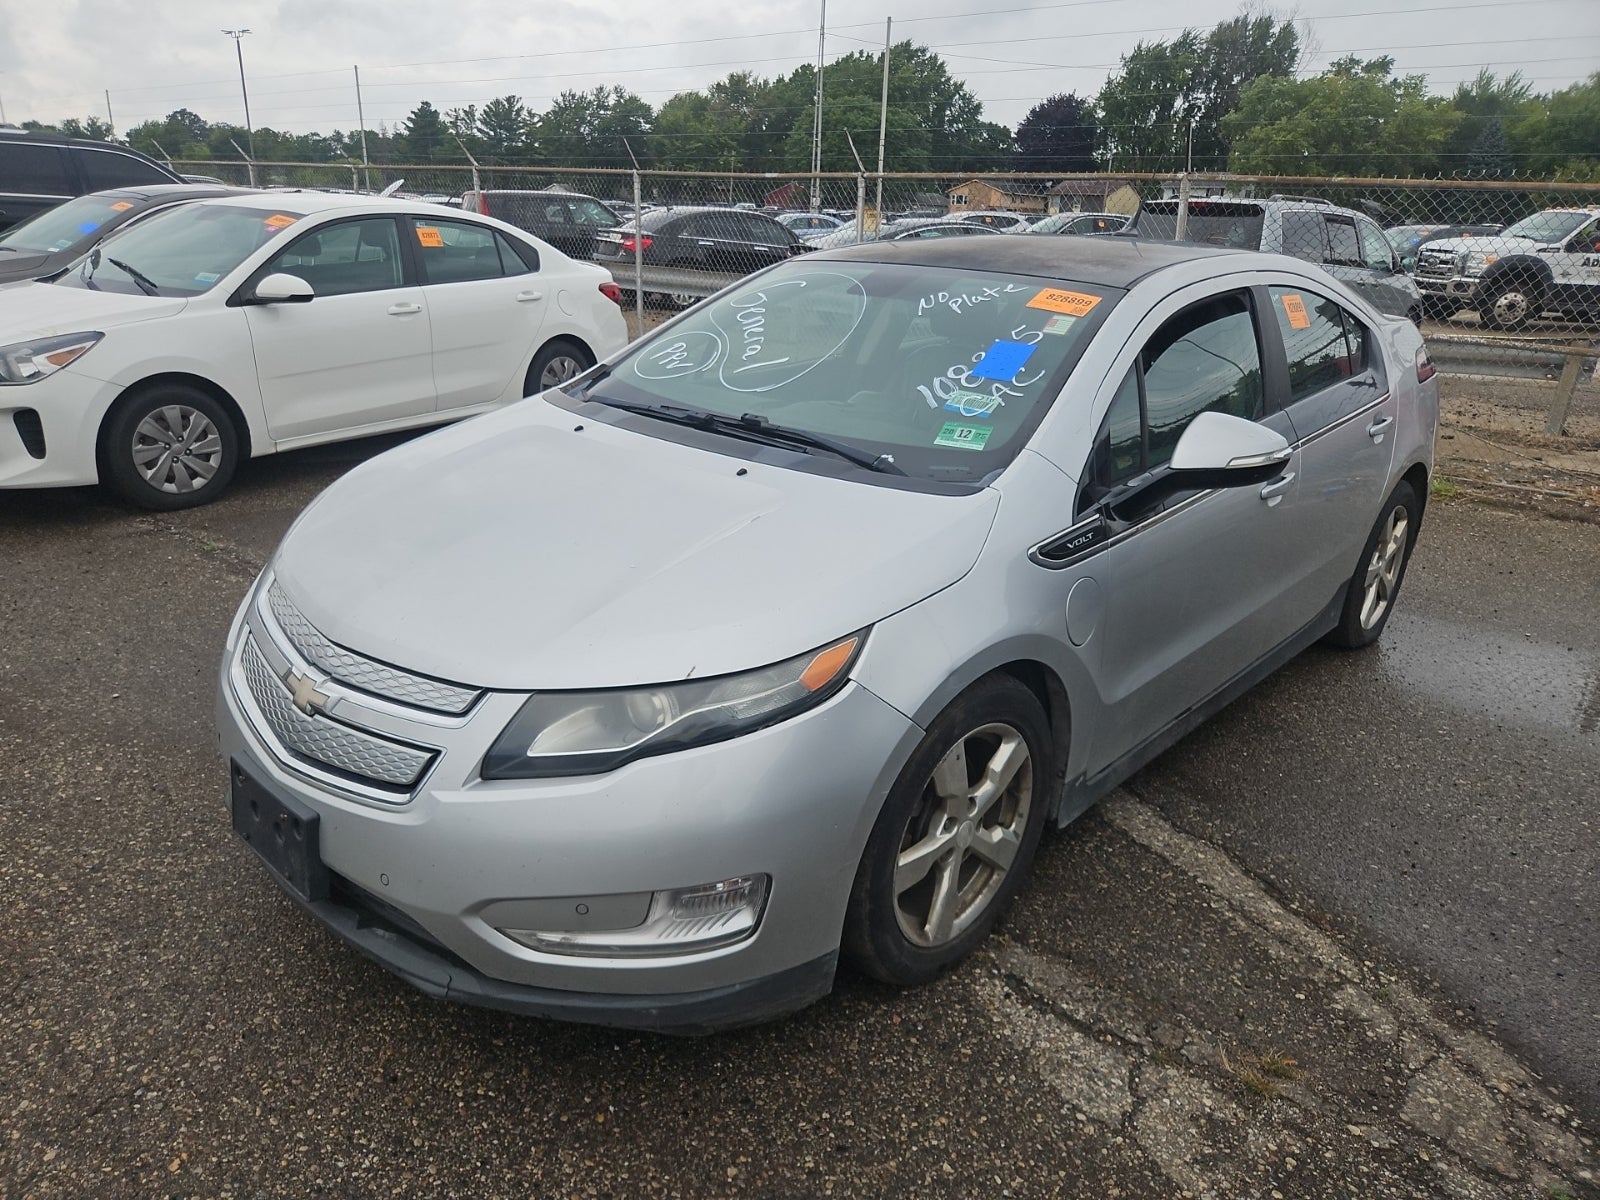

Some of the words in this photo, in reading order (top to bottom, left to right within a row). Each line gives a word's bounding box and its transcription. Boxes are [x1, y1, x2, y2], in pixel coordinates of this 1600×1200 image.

[1045, 293, 1093, 308] 828899
[957, 428, 973, 439] 12
[1066, 531, 1095, 549] VOLT
